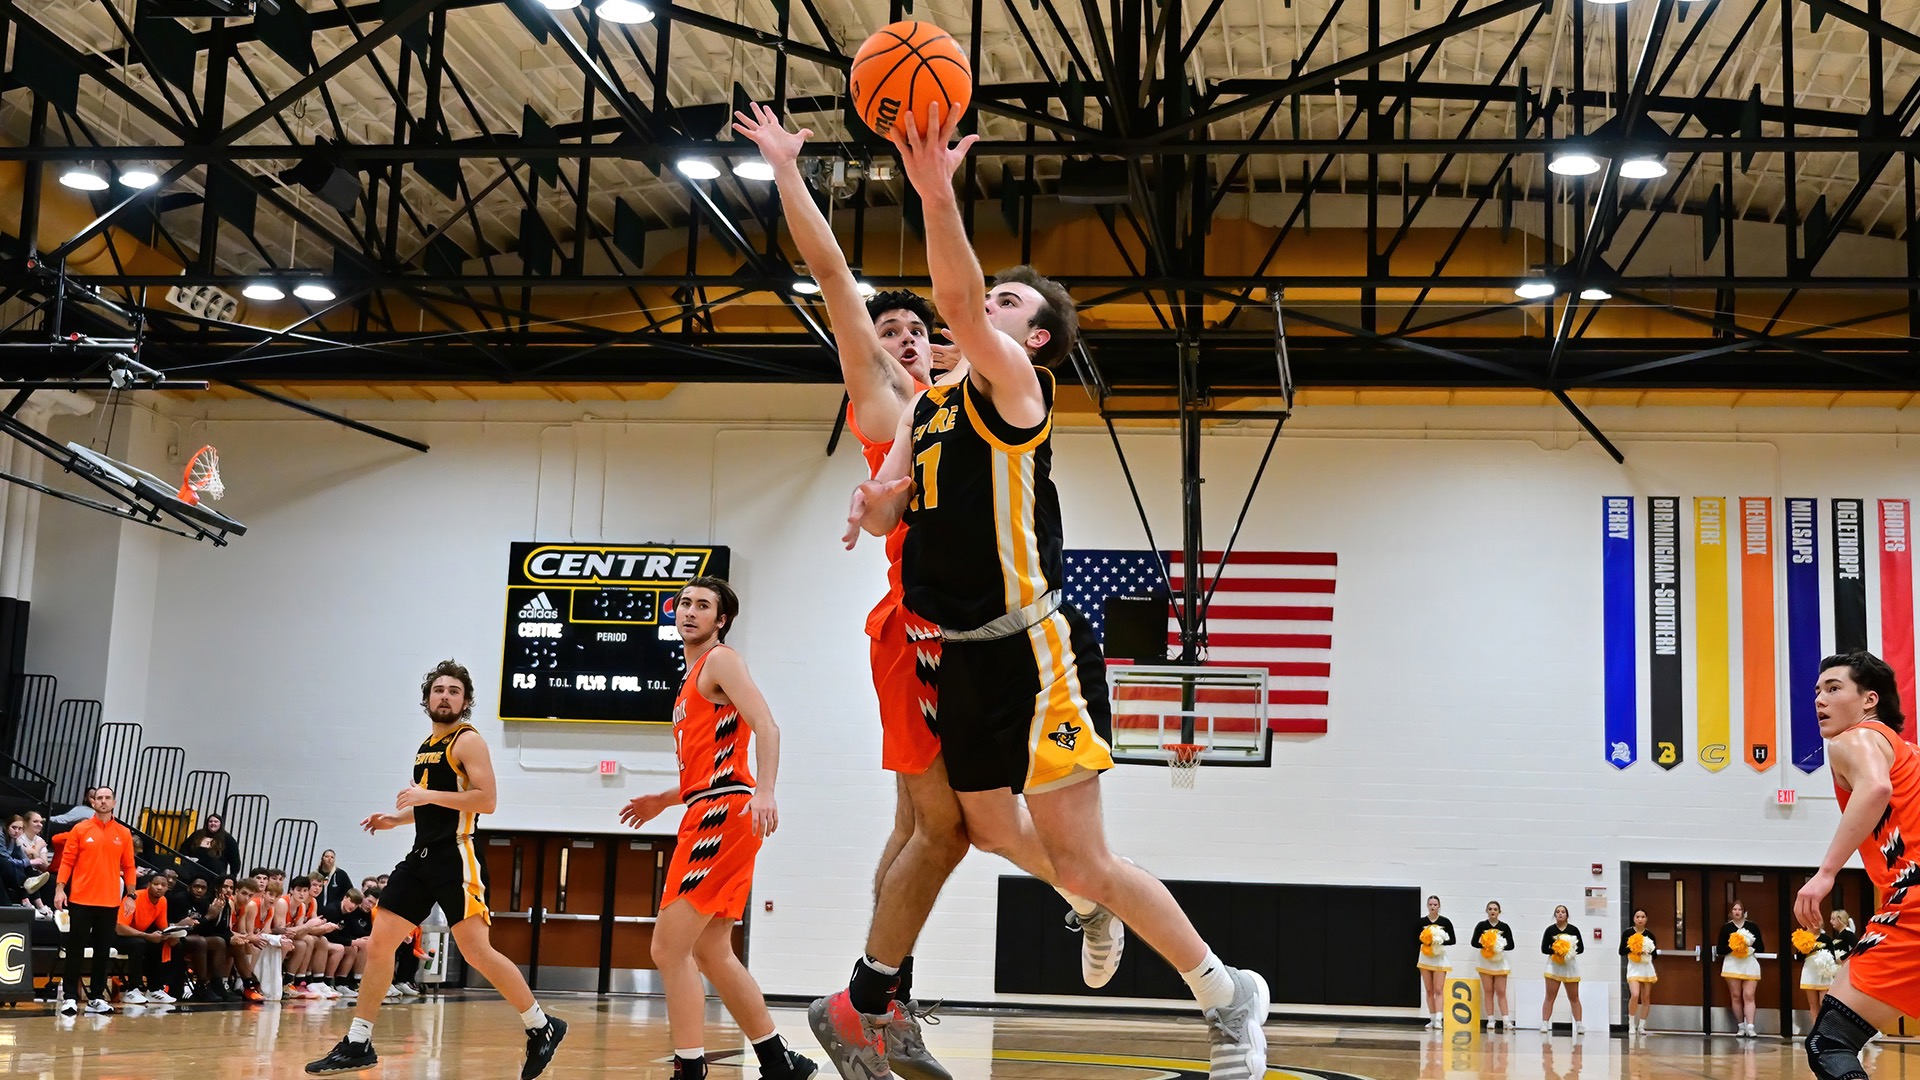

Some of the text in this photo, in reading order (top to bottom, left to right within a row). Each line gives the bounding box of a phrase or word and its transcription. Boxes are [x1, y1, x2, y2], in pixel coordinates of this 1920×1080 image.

[1608, 499, 1629, 540] BERRY
[1700, 500, 1721, 545] CENTRE
[1745, 500, 1767, 555] HENDRIX
[1791, 501, 1813, 564] MILLSAPS
[1883, 502, 1906, 552] RHODES
[1837, 501, 1860, 580] OGLETHORPE
[530, 553, 700, 579] CENTRE
[1654, 499, 1676, 655] BIRMINGHAM-SOUTHERN
[518, 609, 558, 619] adidas
[596, 632, 628, 642] PERIOD
[512, 673, 537, 690] FLS
[549, 677, 572, 688] T.O.L.
[647, 680, 670, 690] T.O.L.
[600, 760, 617, 774] EXIT
[1777, 789, 1795, 803] EXIT
[1452, 981, 1472, 1025] GO
